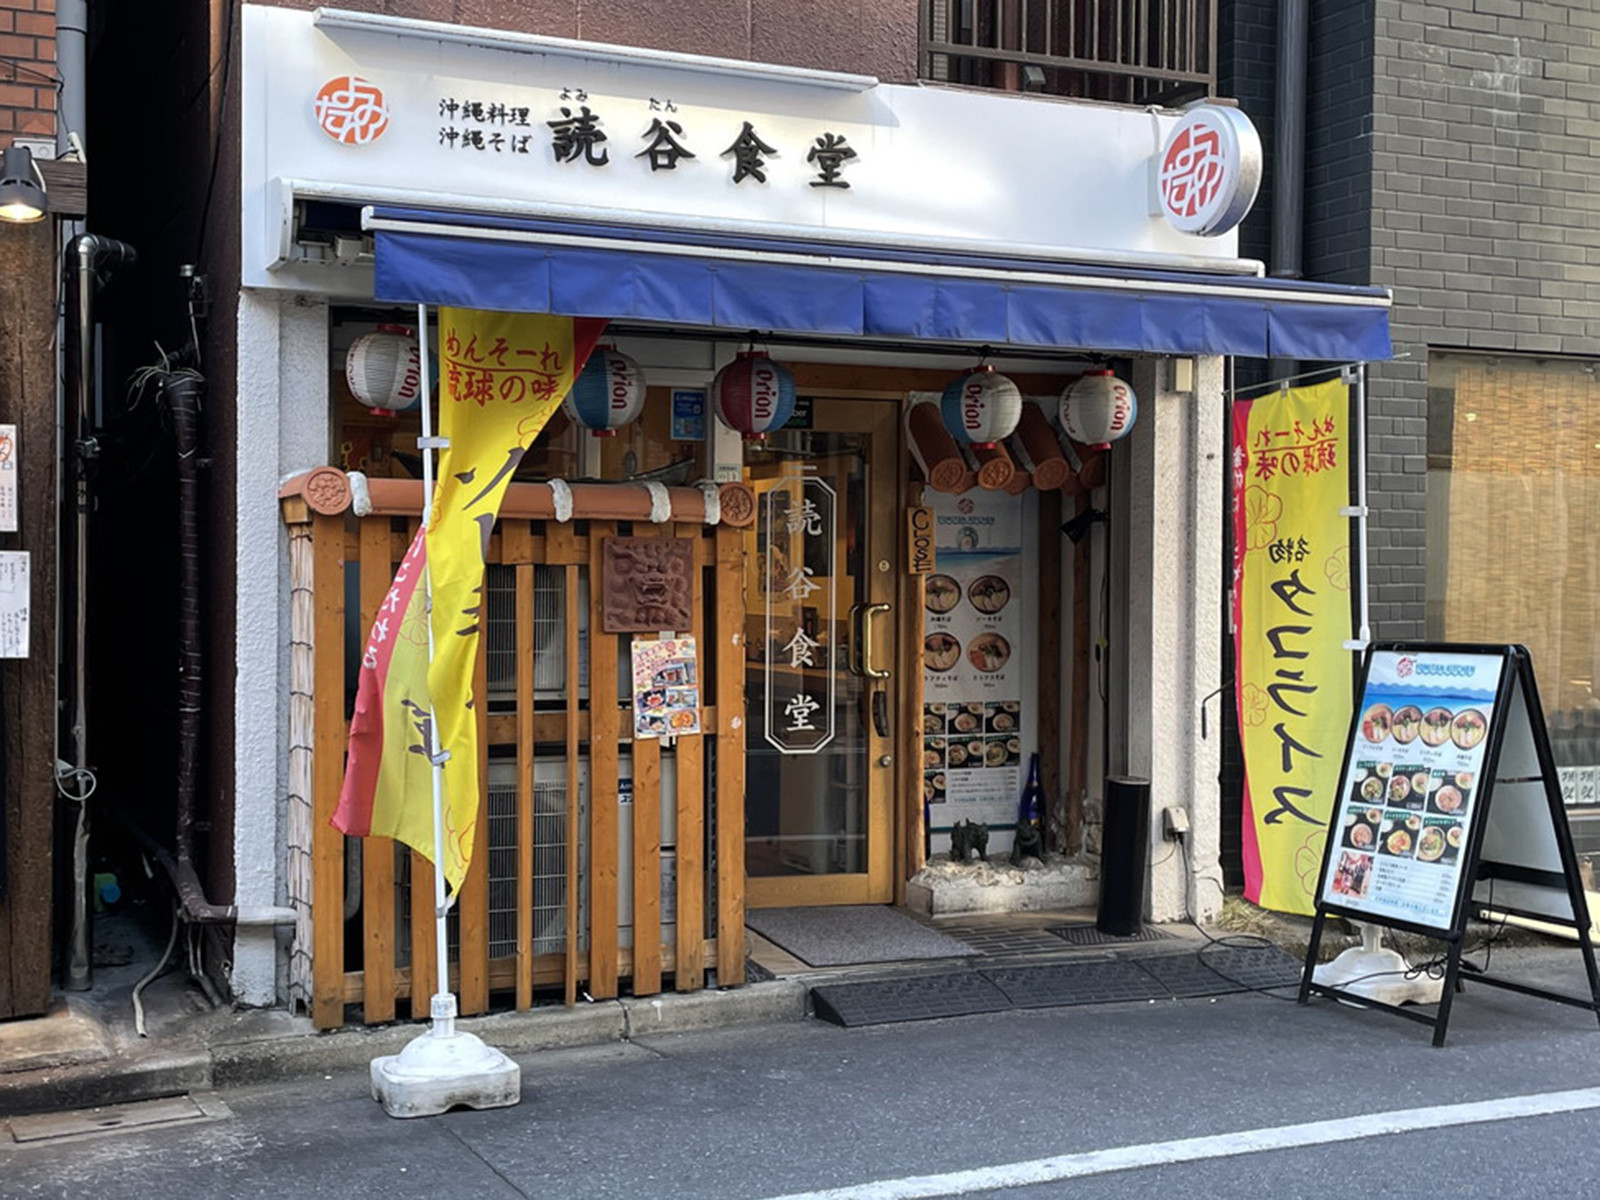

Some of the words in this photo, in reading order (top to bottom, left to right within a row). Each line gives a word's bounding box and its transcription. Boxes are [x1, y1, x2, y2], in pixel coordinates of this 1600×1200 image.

[439, 97, 531, 127] 沖縄料理
[558, 87, 589, 102] よみ
[648, 97, 678, 113] たん
[439, 126, 532, 153] 沖縄そば
[546, 106, 858, 189] 読谷食堂
[446, 328, 563, 371] めんそーれ
[610, 359, 632, 410] Orion
[754, 368, 774, 420] Orion
[964, 383, 985, 431] Orion
[1109, 384, 1132, 432] Orion
[782, 499, 823, 732] 読谷食堂
